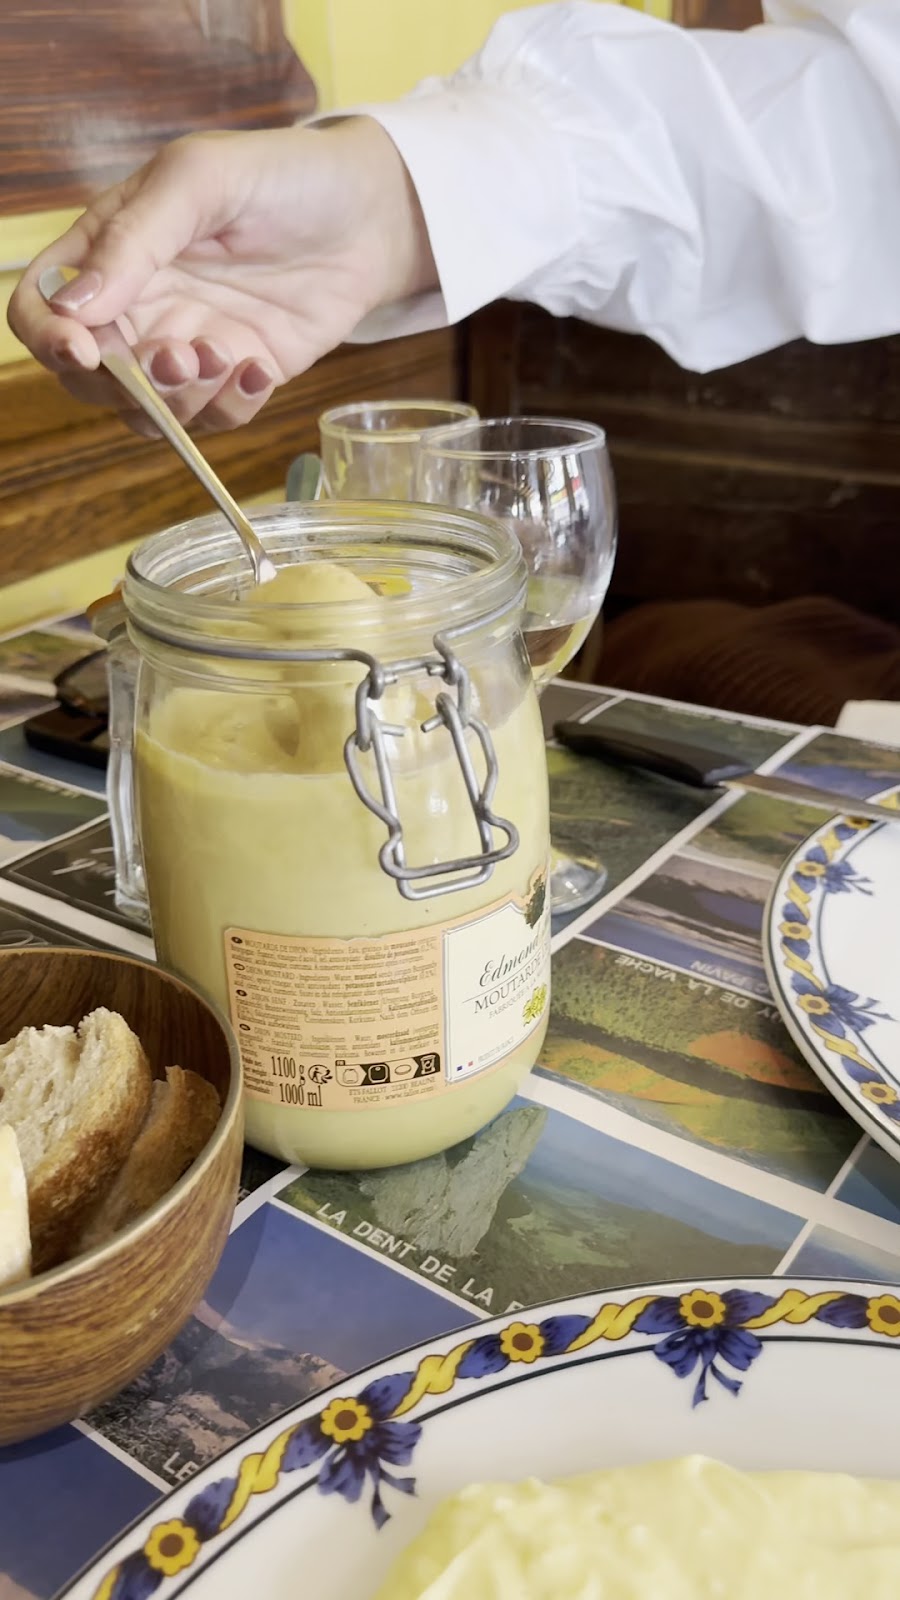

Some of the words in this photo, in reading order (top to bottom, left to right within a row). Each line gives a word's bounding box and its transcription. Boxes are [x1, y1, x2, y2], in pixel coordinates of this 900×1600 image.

[614, 954, 677, 983] VACHE
[690, 960, 747, 986] PAVIN
[687, 978, 713, 995] LA
[719, 991, 750, 1009] DE
[271, 1055, 296, 1079] 1100
[298, 1064, 306, 1086] g
[279, 1083, 305, 1106] 1000
[307, 1085, 323, 1107] ml
[353, 1095, 380, 1104] FRANCE
[316, 1202, 349, 1226] LA
[352, 1220, 417, 1260] DENT
[419, 1255, 457, 1283] DE
[460, 1277, 495, 1307] LA
